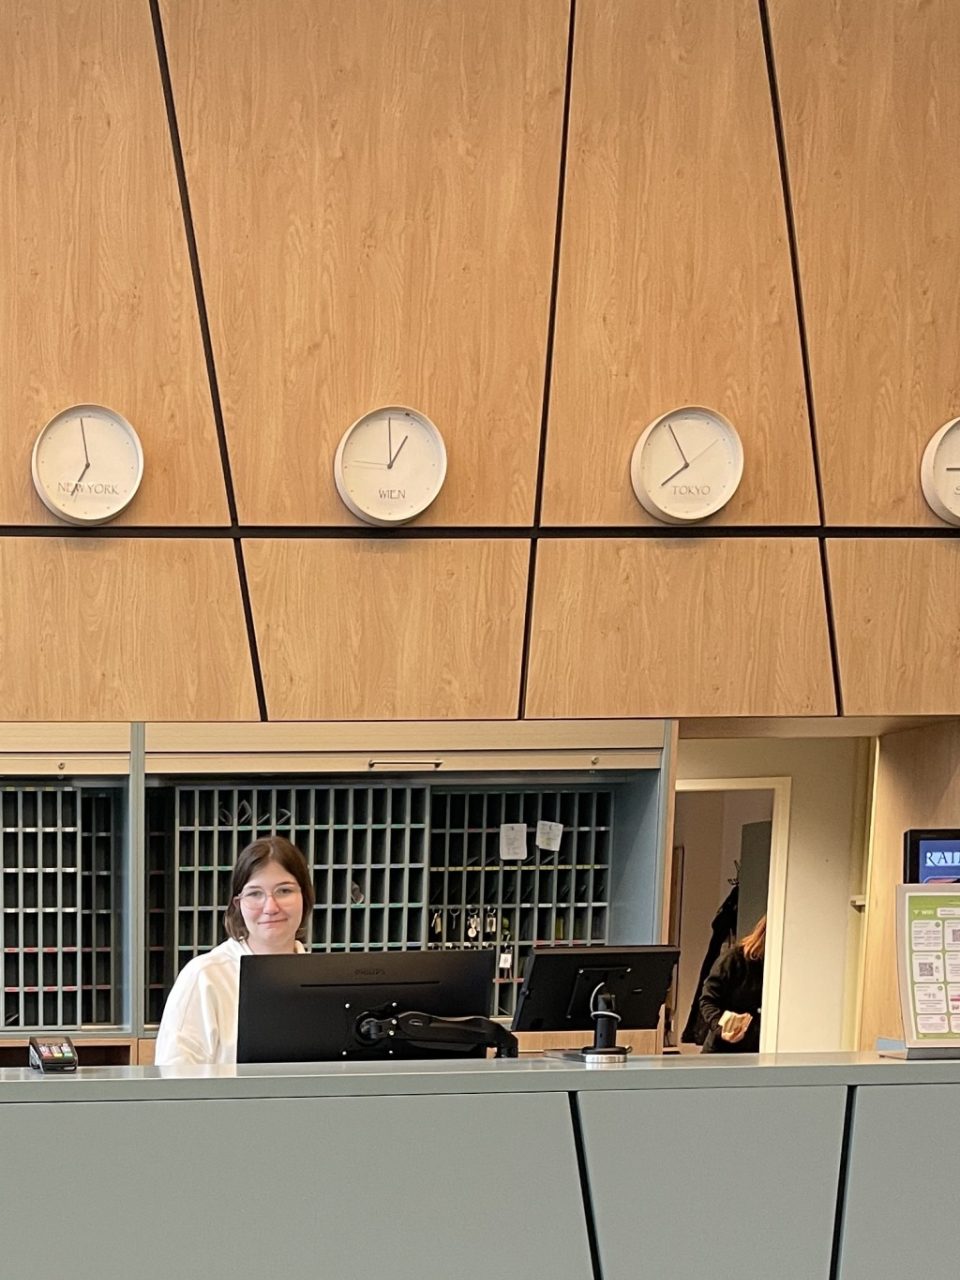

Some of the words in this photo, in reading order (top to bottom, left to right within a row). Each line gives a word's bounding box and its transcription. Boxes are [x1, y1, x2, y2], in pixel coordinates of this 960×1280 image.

[58, 482, 83, 493] NEW
[87, 483, 119, 495] YORK
[378, 489, 406, 499] WIEN
[672, 485, 711, 496] TOKYO
